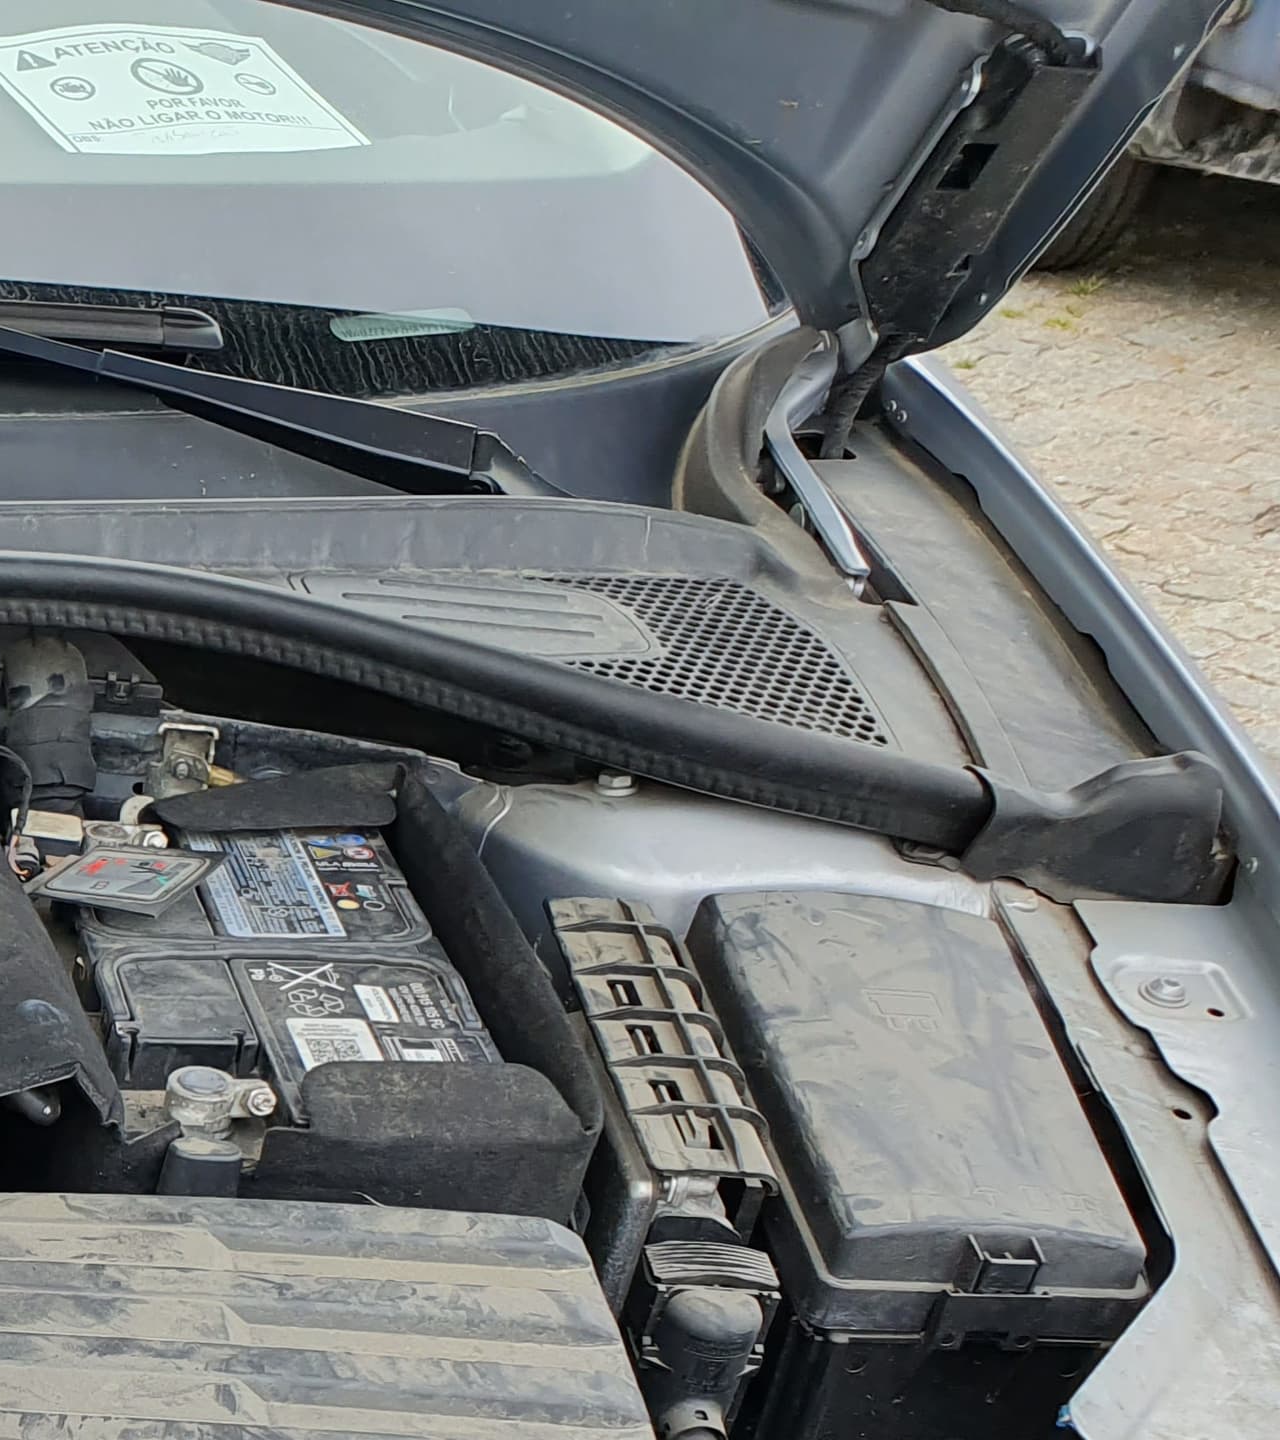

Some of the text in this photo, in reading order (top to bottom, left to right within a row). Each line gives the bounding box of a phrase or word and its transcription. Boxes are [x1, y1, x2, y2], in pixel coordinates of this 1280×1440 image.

[54, 37, 175, 59] ATENÇÃO
[146, 97, 247, 111] POR FAVOR
[88, 117, 135, 131] NÃO
[138, 111, 203, 126] LIGAR
[205, 110, 221, 120] O
